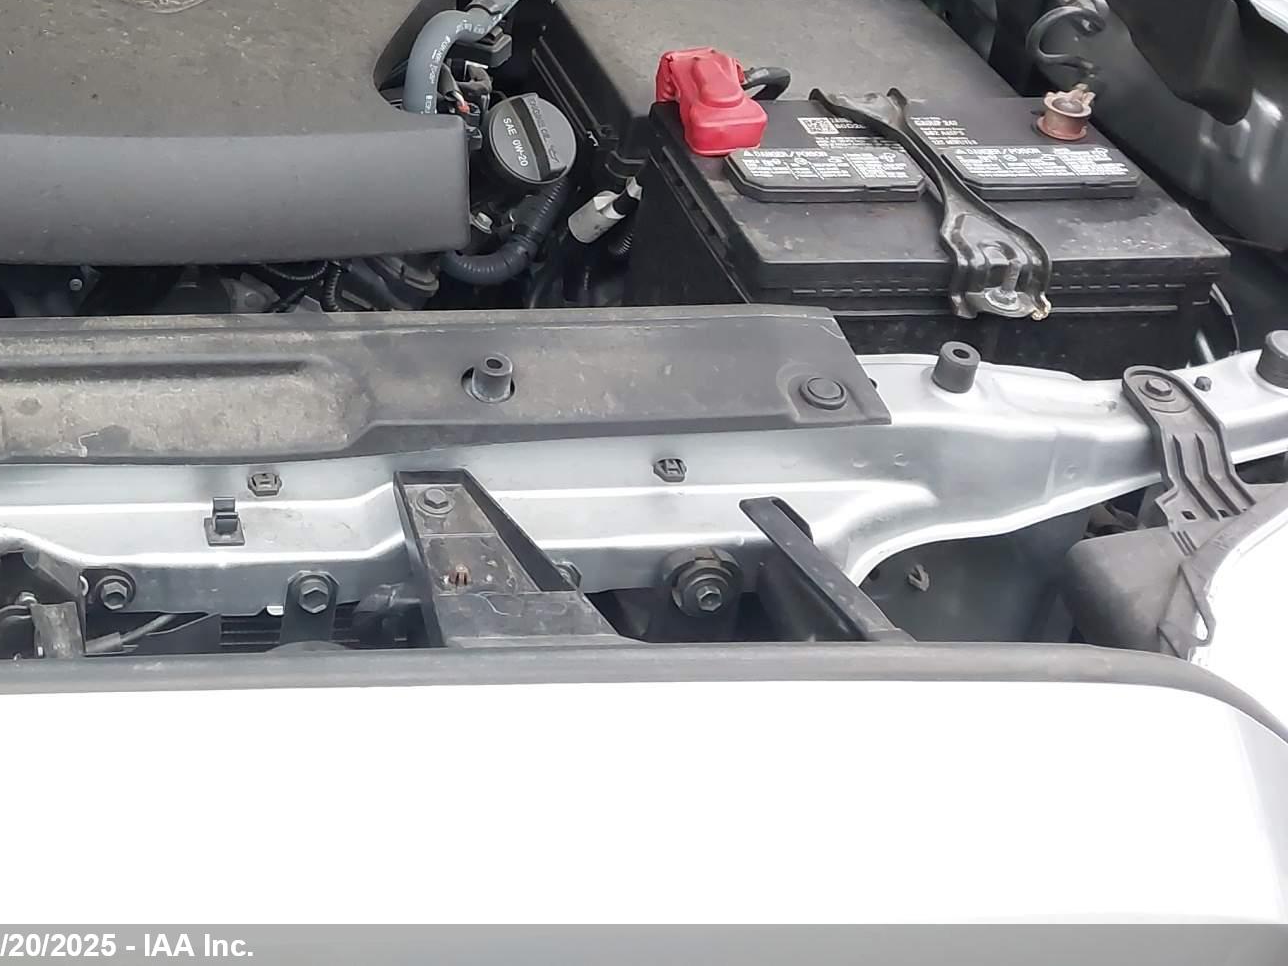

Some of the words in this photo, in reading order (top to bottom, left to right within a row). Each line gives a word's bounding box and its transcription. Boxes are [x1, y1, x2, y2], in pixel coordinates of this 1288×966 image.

[528, 97, 546, 127] ENGINE
[503, 117, 518, 136] SAE
[512, 139, 529, 167] 0W-20
